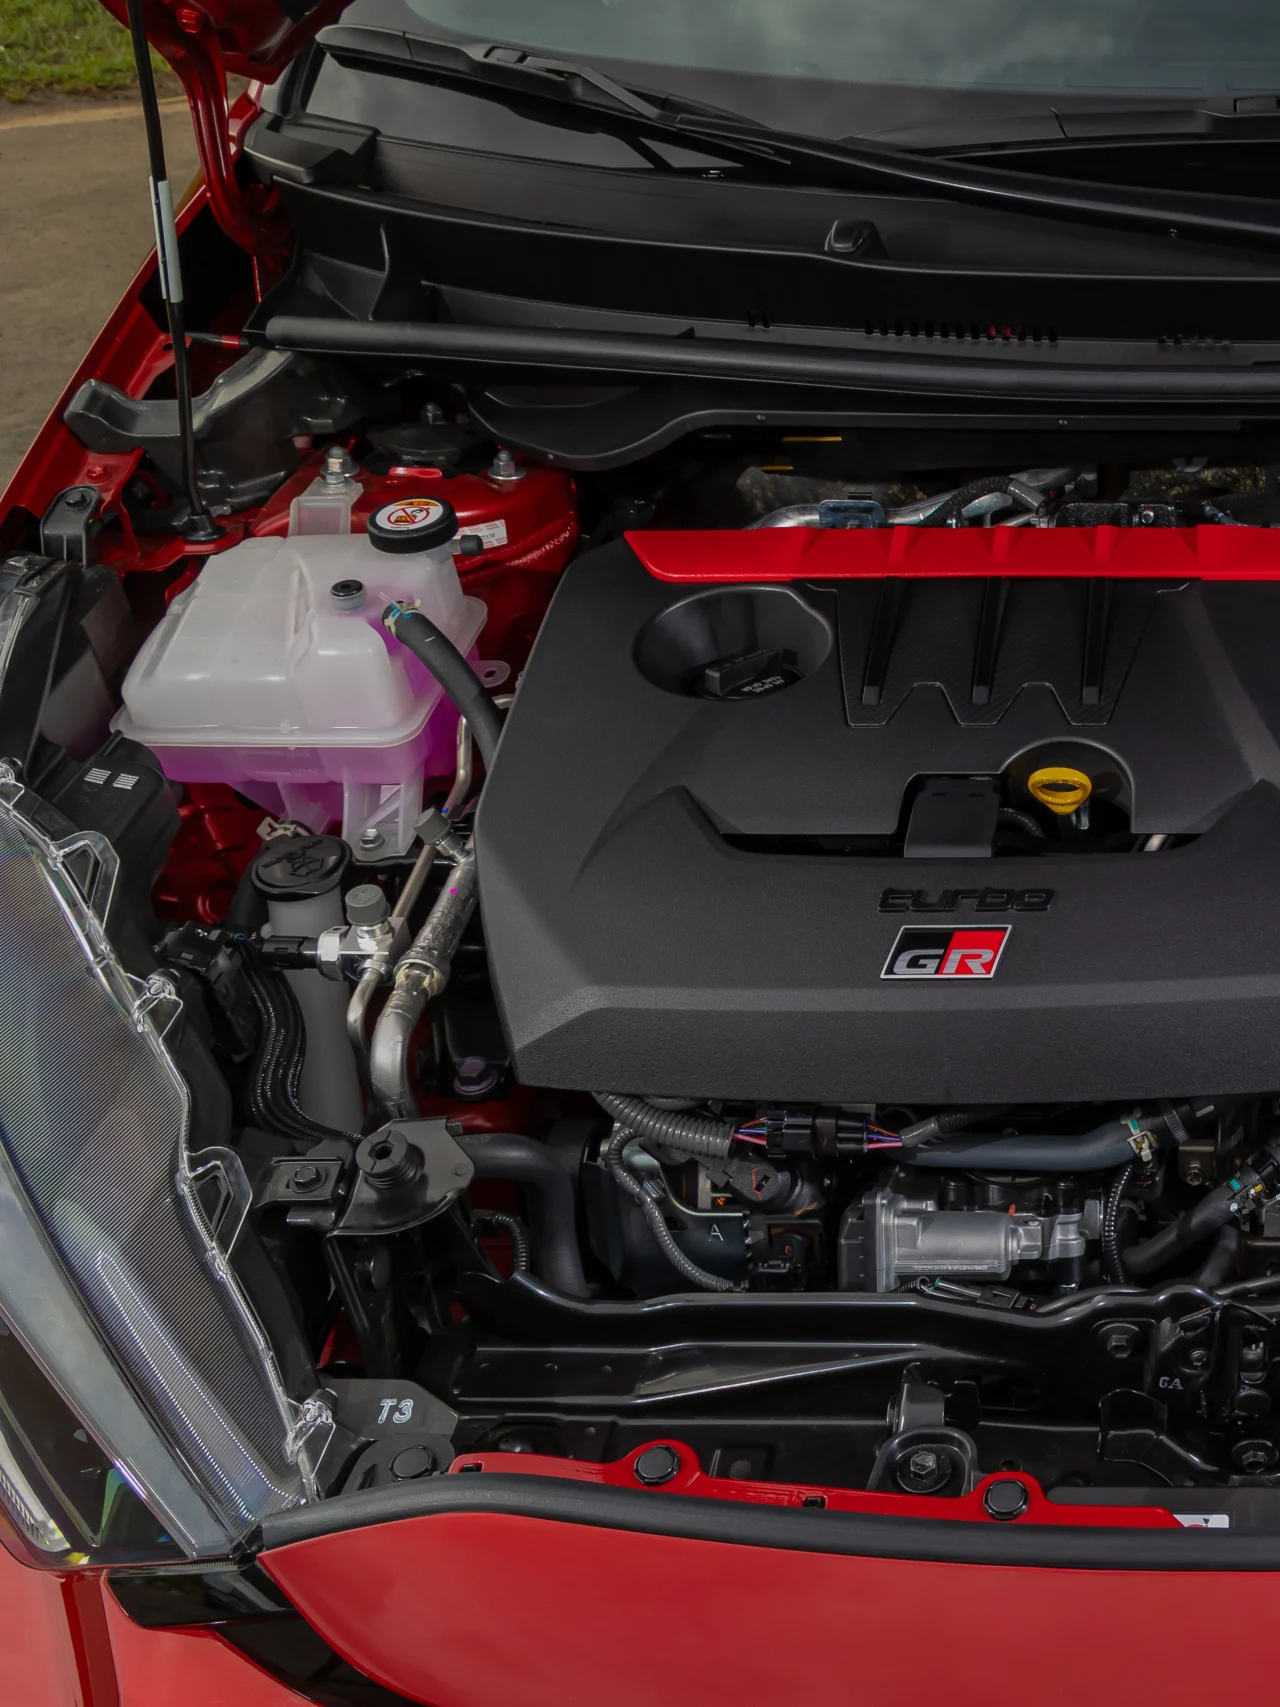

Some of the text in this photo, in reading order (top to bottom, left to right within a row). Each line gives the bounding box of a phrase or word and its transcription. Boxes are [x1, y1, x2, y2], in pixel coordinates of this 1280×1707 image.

[877, 887, 1056, 913] turbo
[892, 948, 995, 975] GR
[708, 1223, 724, 1242] A
[377, 1398, 414, 1424] T3
